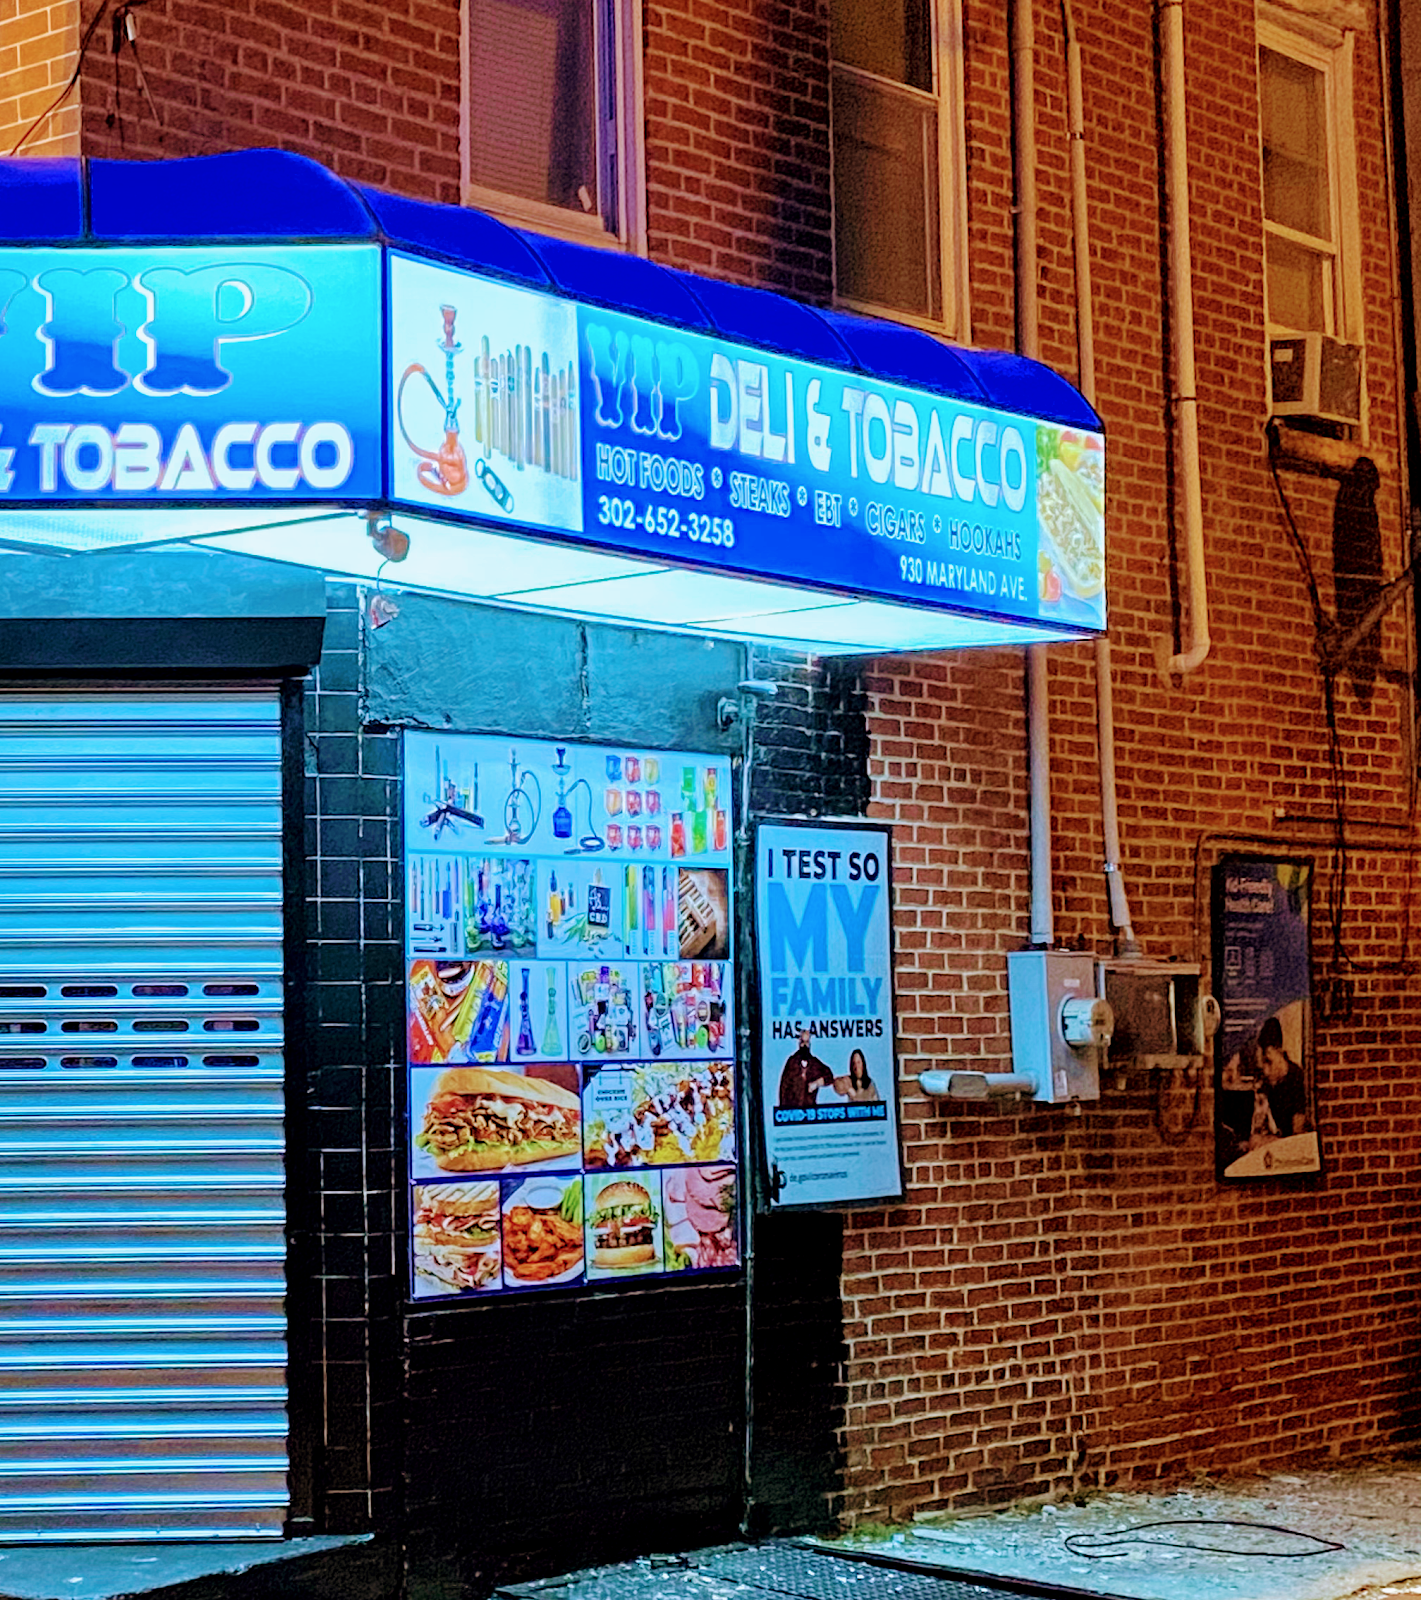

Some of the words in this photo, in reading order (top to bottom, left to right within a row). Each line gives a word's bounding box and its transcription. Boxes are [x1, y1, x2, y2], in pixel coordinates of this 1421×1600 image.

[585, 322, 700, 441] VIP
[29, 420, 355, 493] TOBACCO
[709, 352, 797, 465] DELI
[805, 377, 834, 473] &
[841, 385, 1028, 513] TOBACCO
[596, 442, 639, 485] HOT
[639, 456, 705, 500] FOODS
[729, 470, 791, 518] STEAKS
[815, 490, 843, 528] EBT
[865, 501, 927, 545] CIGARS
[948, 519, 1022, 562] HOOKAHS
[598, 495, 736, 549] 302-652-3258
[900, 554, 923, 583] 930
[926, 557, 996, 597] MARYLAND
[999, 571, 1028, 602] AVE.
[767, 847, 774, 878] I
[782, 849, 842, 881] TEST
[848, 851, 880, 882] SO
[767, 882, 881, 973] MY
[771, 976, 883, 1017] FAMILY
[772, 1020, 803, 1040] HAS
[809, 1019, 884, 1039] ANSWERS
[774, 1108, 816, 1123] COVID-19
[817, 1106, 846, 1120] STOPS
[847, 1105, 871, 1118] WITH
[871, 1104, 885, 1117] ME
